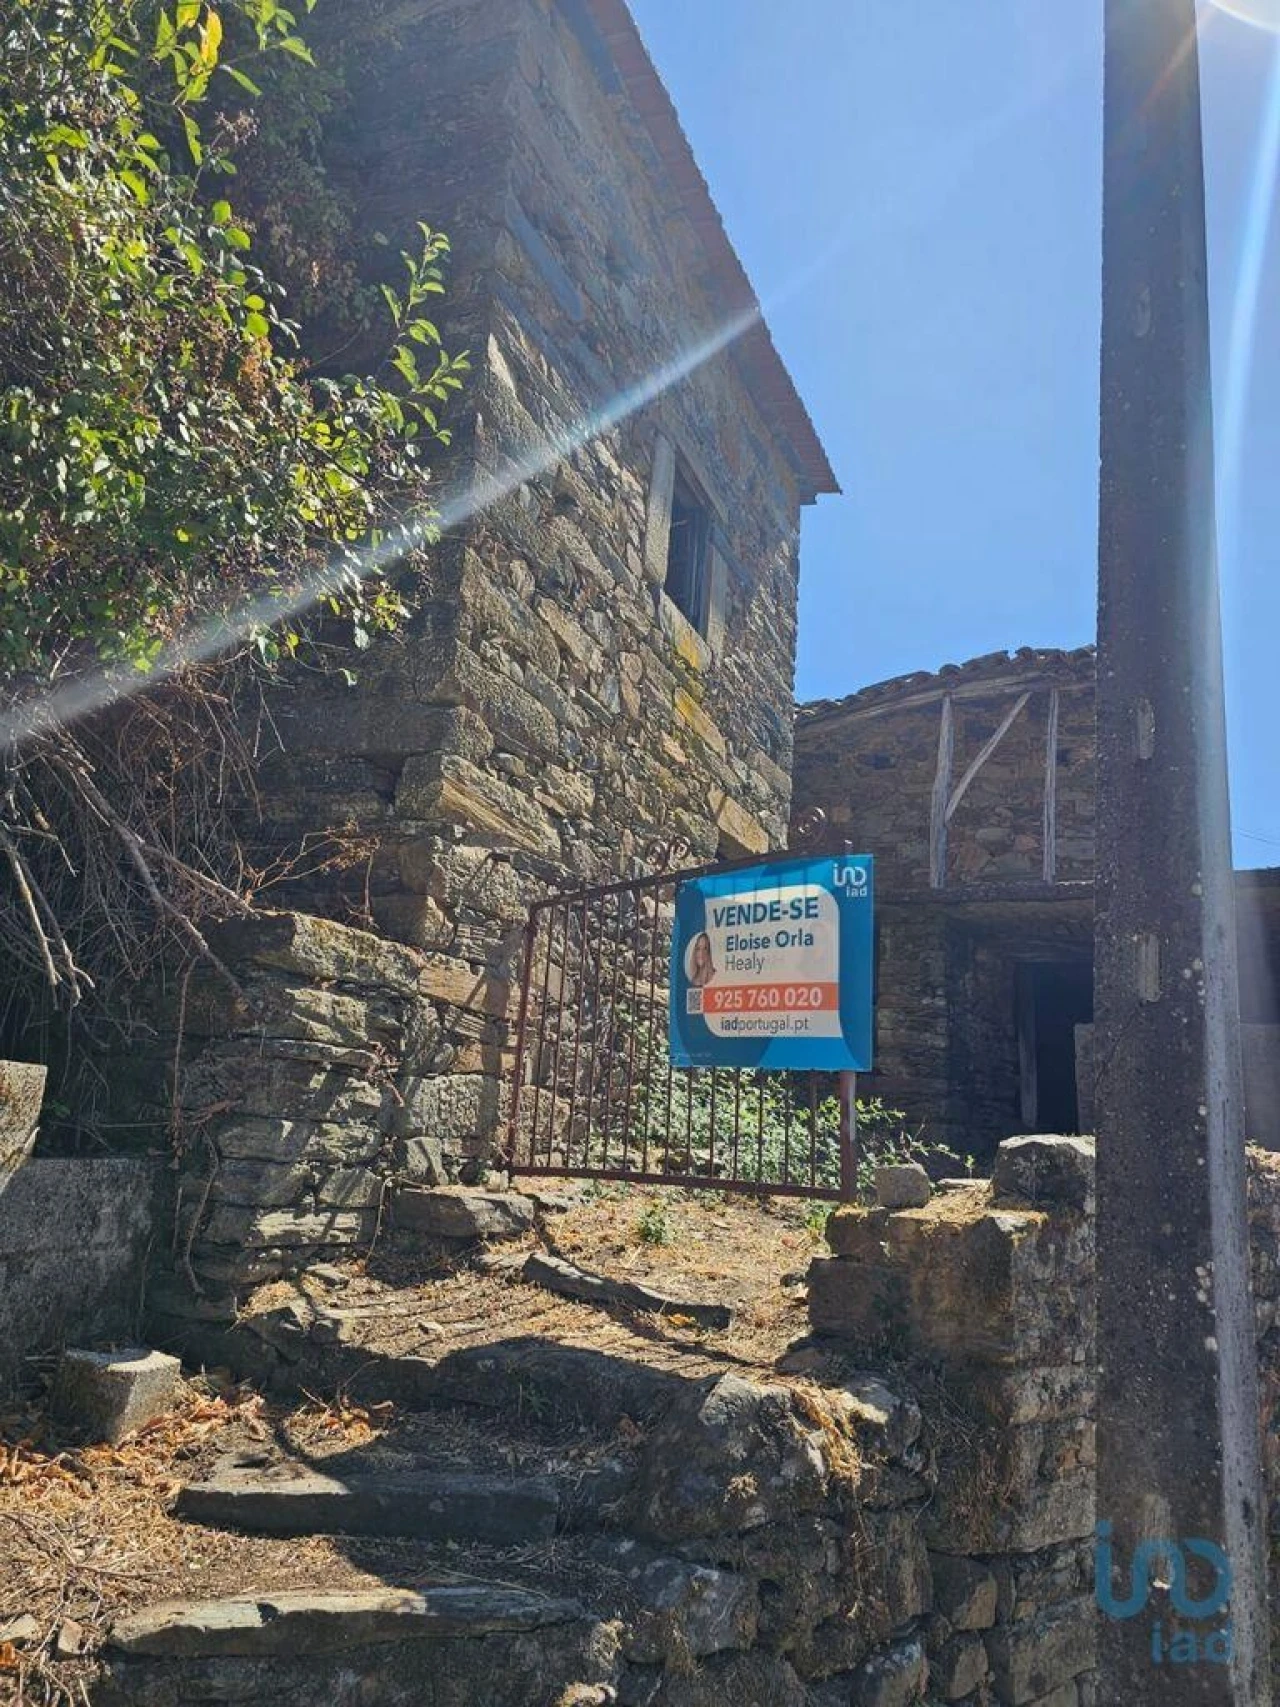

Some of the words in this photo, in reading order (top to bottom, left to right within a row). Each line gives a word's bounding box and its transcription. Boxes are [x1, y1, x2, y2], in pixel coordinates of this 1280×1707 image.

[845, 885, 868, 898] iad
[713, 897, 819, 928] VENDE-SE
[726, 933, 771, 952] Eloise
[775, 928, 814, 948] Orla
[725, 952, 765, 974] Healy
[714, 989, 743, 1009] 925
[748, 988, 780, 1007] 760
[785, 986, 822, 1006] 020
[720, 1015, 809, 1032] iadportugal.pt
